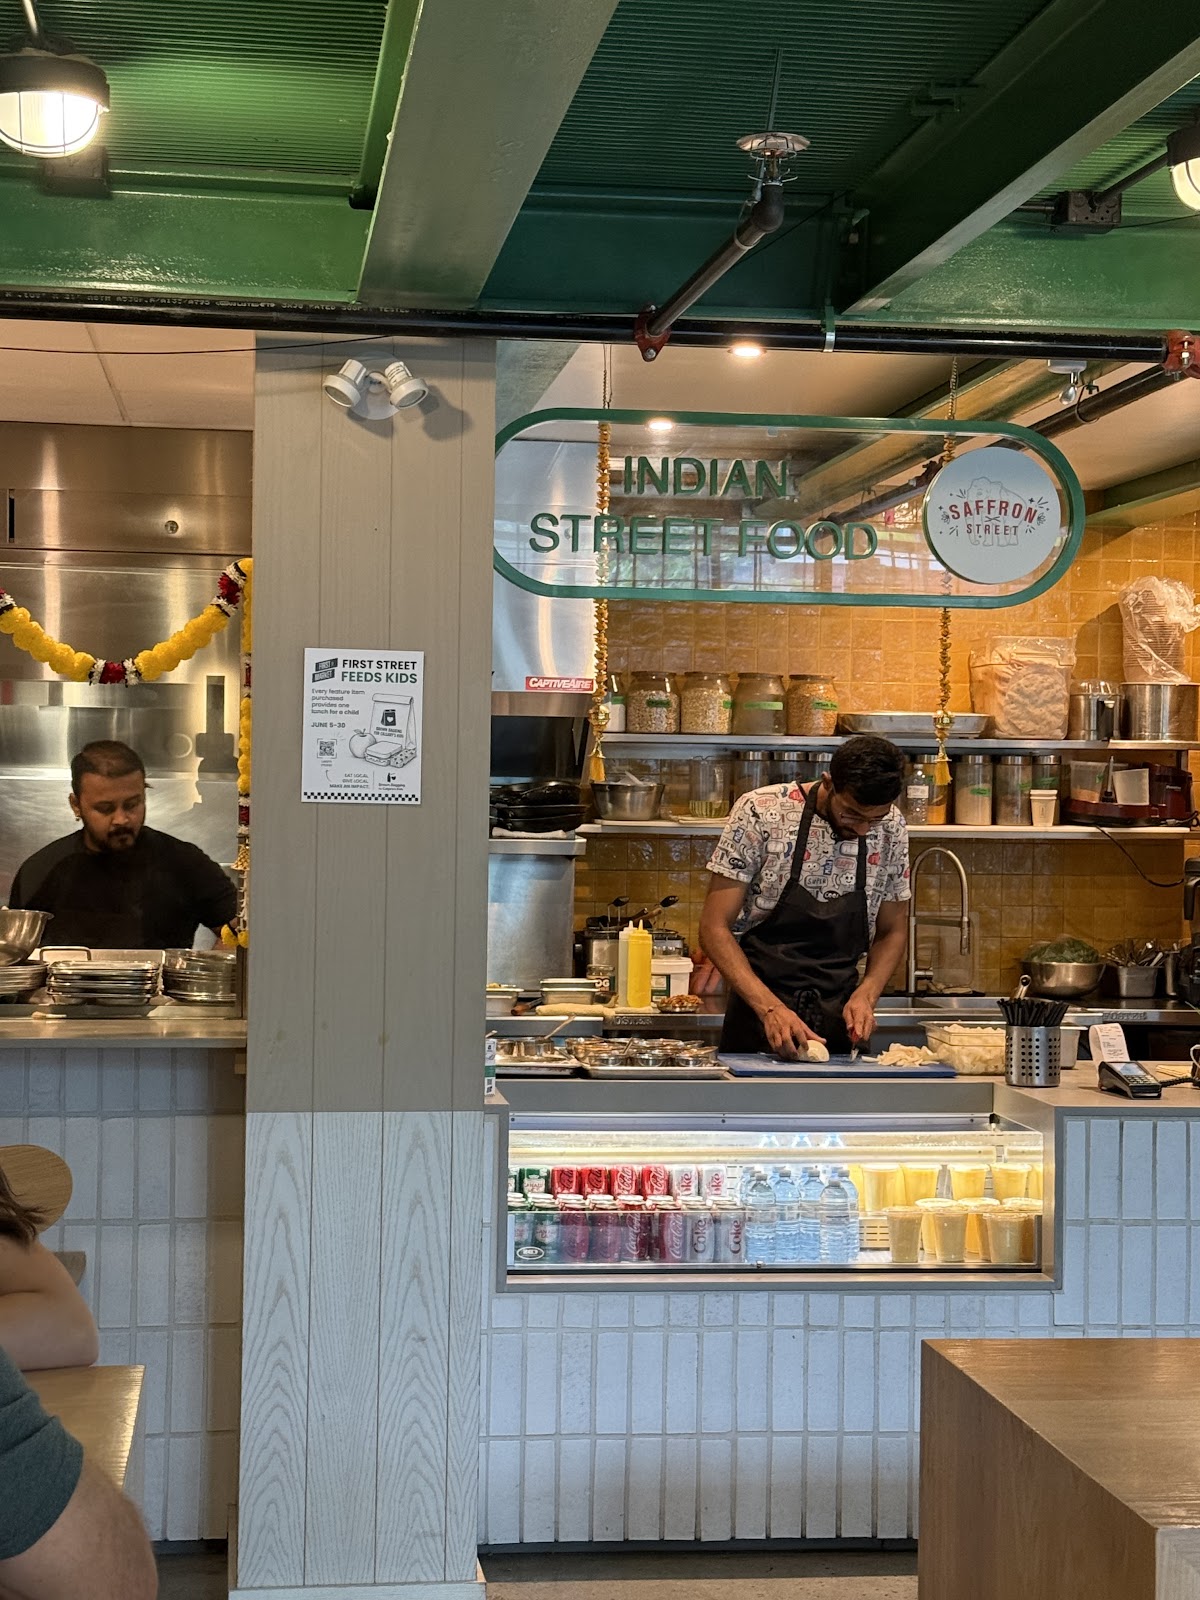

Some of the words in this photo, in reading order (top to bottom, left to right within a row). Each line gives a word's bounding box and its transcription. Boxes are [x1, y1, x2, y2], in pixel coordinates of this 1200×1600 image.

[623, 455, 787, 497] INDIAN
[948, 499, 1038, 524] SAFFRON
[529, 512, 724, 557] STREET
[738, 519, 878, 561] FOOD
[966, 524, 1019, 536] STREET
[341, 671, 382, 683] FEEDS
[385, 672, 418, 684] KIDS
[342, 659, 374, 669] FIRST
[376, 660, 418, 670] STREET
[693, 1219, 707, 1253] Coke
[730, 1219, 741, 1254] Coke
